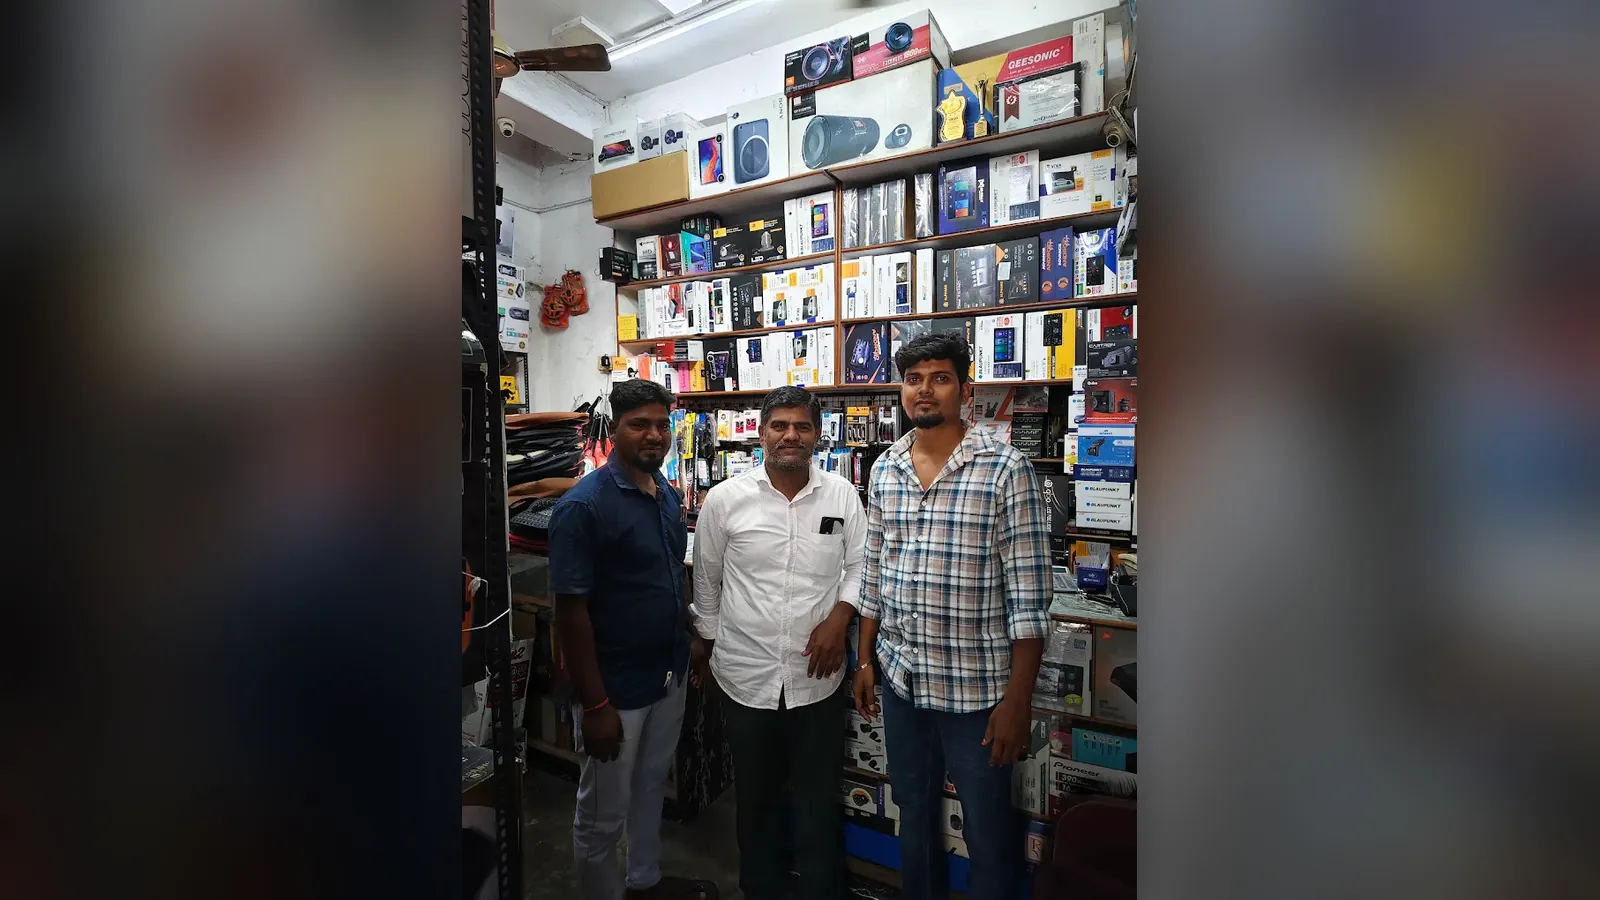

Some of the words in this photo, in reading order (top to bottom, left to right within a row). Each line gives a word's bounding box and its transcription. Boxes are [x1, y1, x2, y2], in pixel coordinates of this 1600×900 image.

[1008, 48, 1061, 70] GEESONIC
[1054, 762, 1100, 777] Pioneer
[1061, 774, 1077, 783] 390
